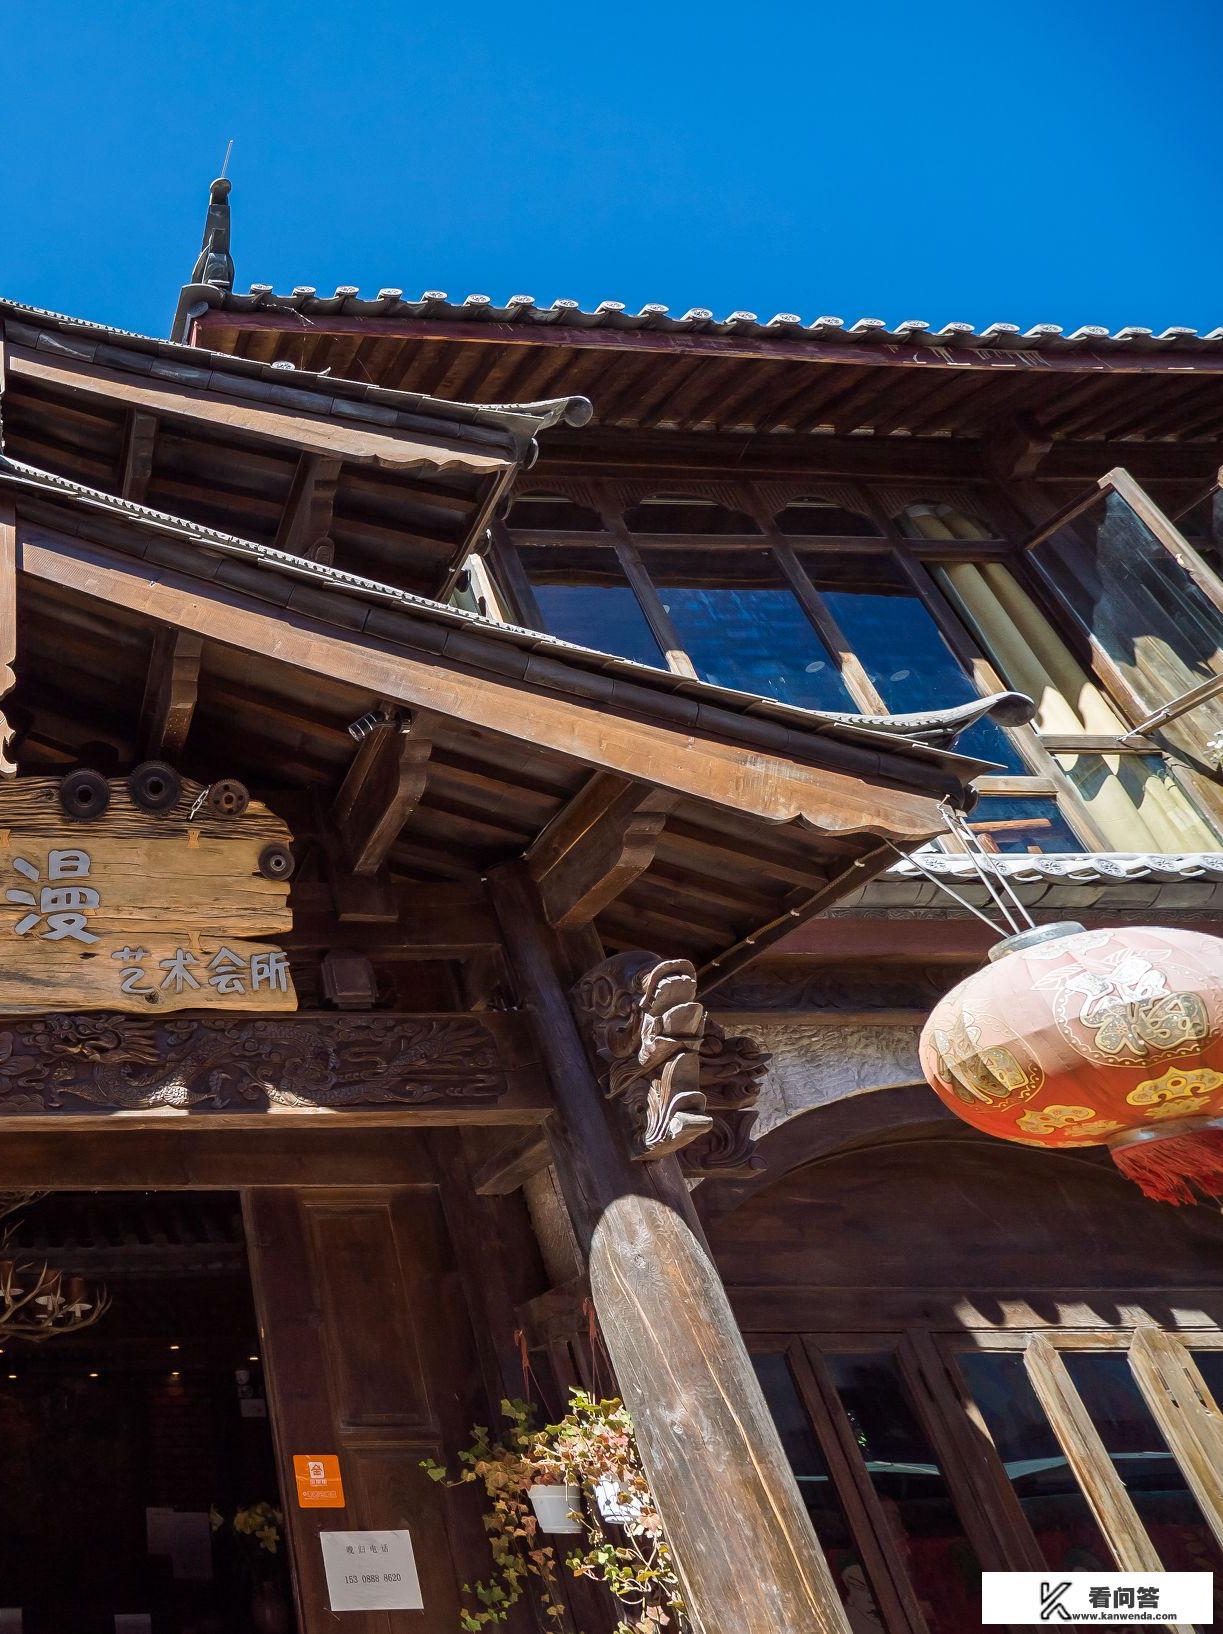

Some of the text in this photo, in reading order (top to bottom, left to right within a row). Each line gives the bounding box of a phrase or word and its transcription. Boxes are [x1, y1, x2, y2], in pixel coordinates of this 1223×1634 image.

[111, 945, 290, 995] 艺术会所
[345, 1575, 358, 1583] 153
[383, 1573, 401, 1582] 8620
